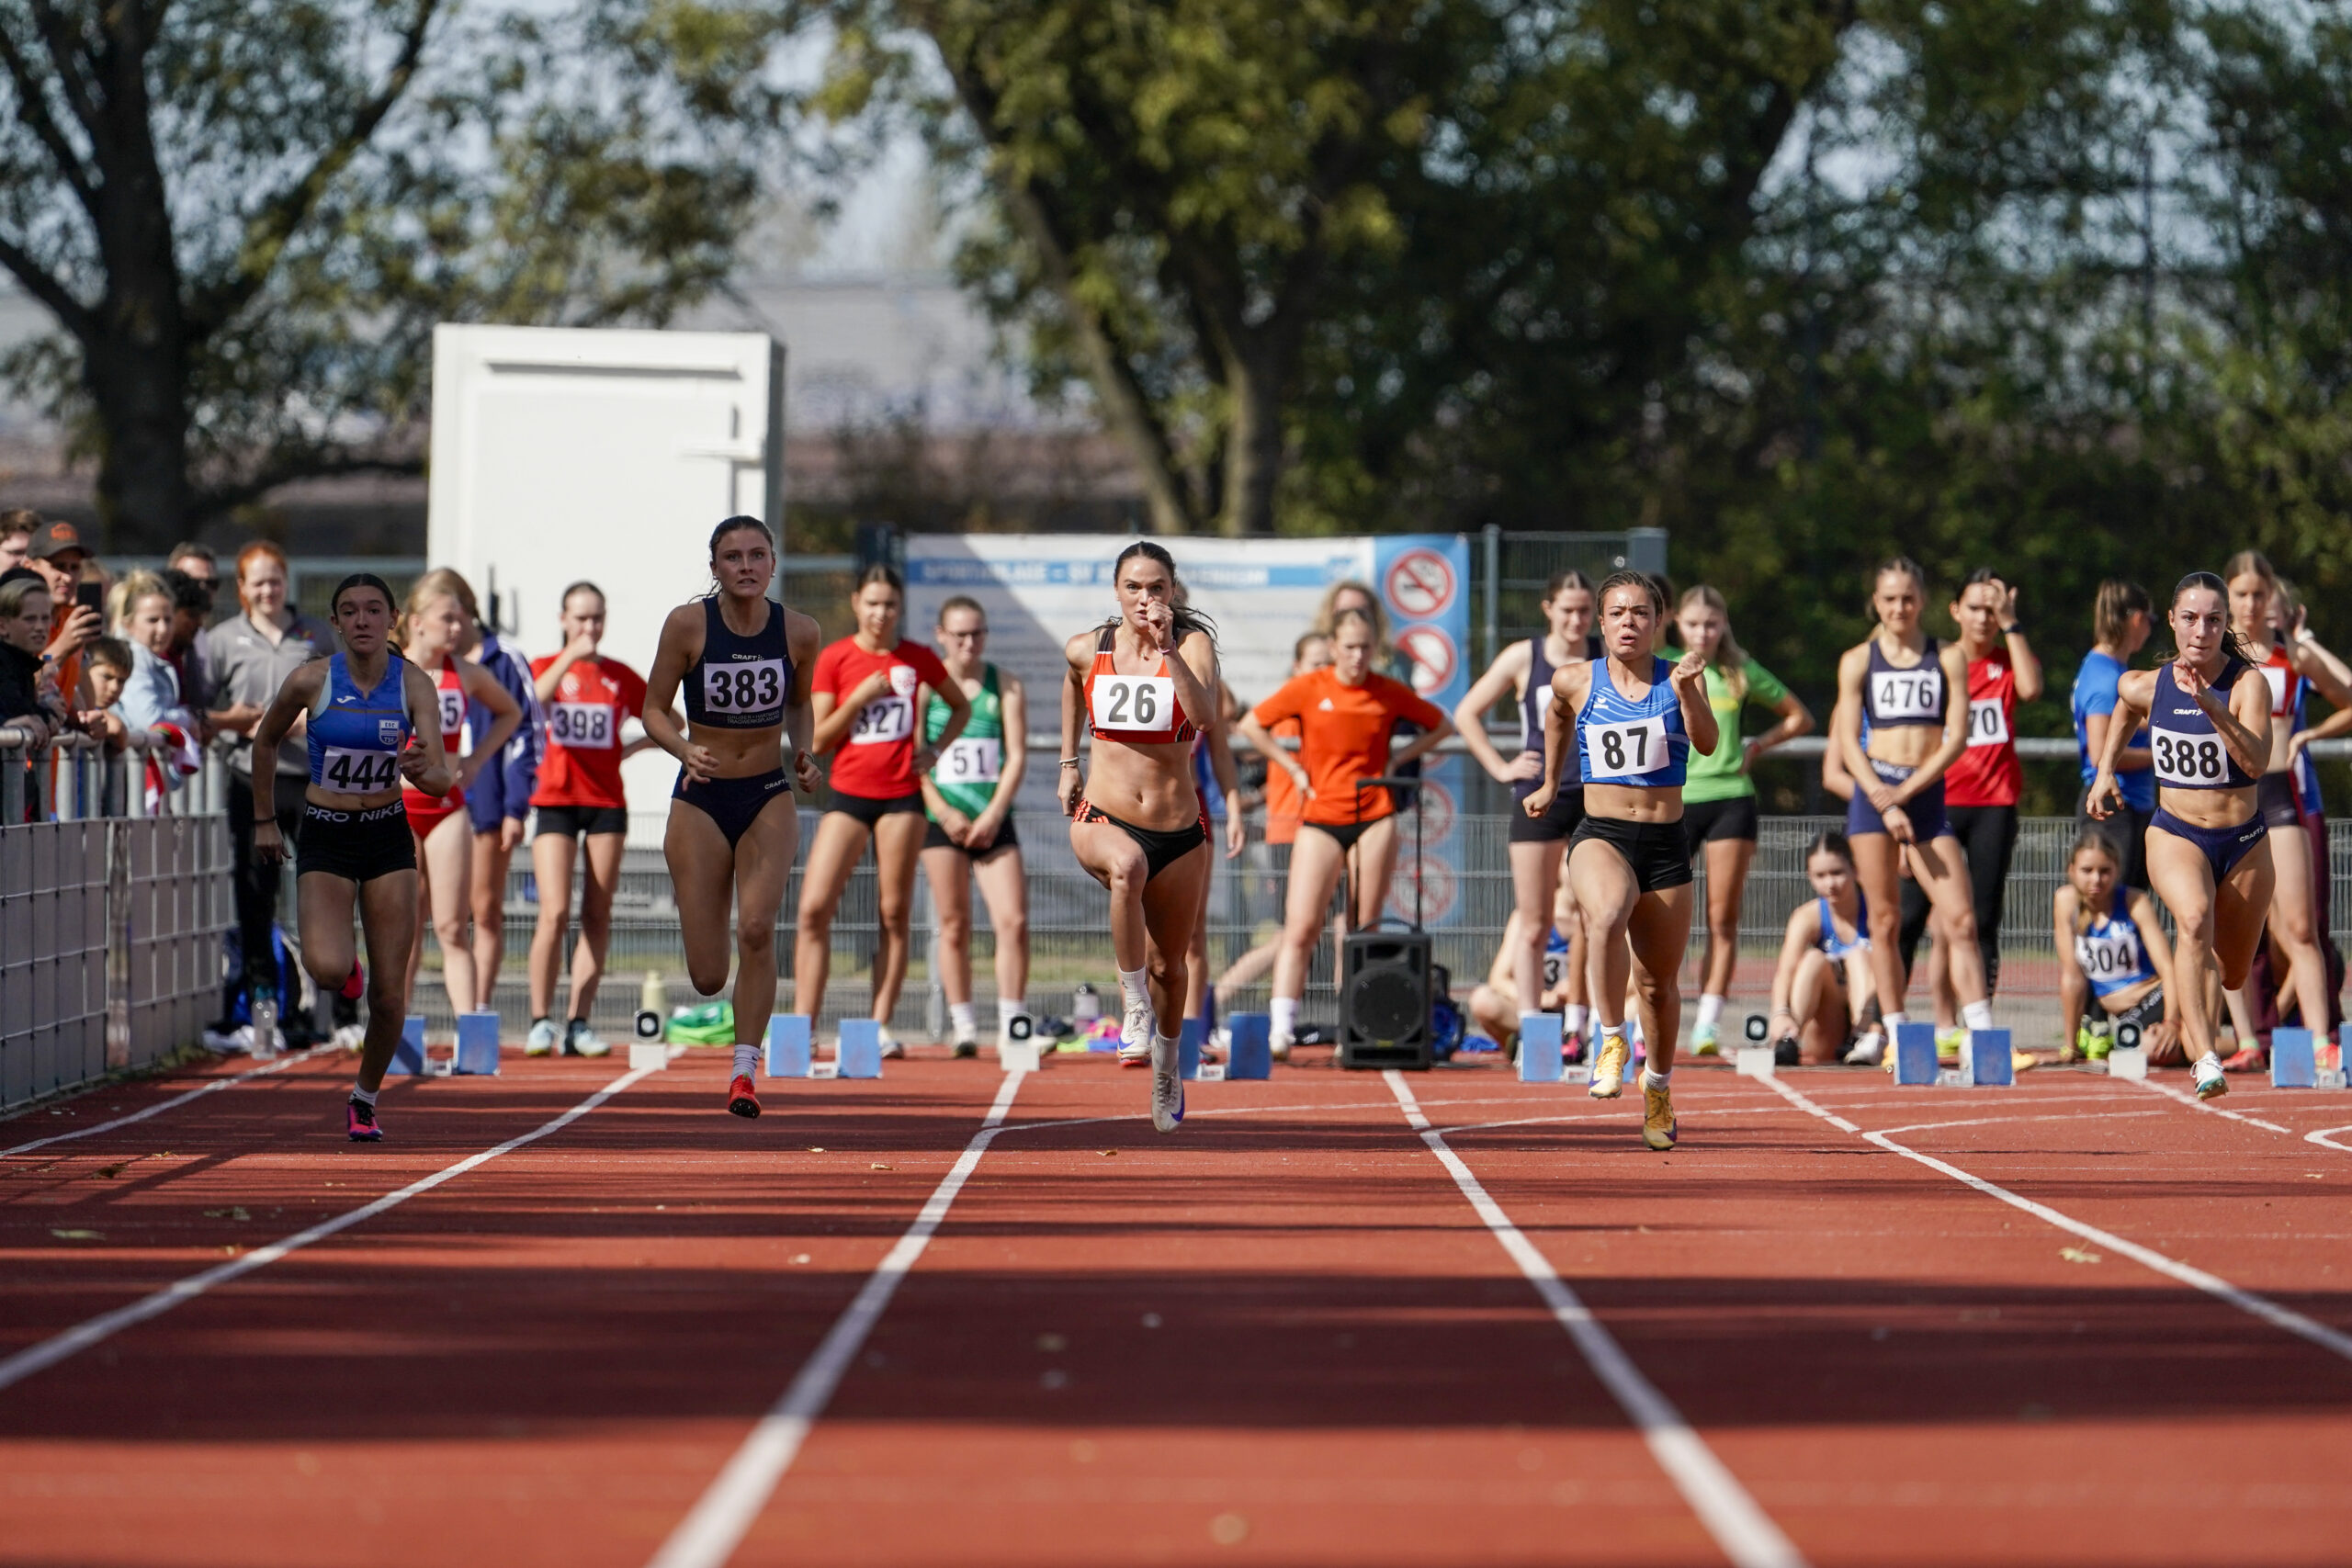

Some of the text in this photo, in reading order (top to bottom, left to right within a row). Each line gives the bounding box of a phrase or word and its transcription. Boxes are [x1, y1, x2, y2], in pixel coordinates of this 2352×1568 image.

[710, 667, 778, 708] 383
[1108, 682, 1156, 724] 26
[1881, 680, 1933, 708] 476
[556, 708, 605, 740] 398
[954, 746, 985, 775] 51
[1601, 727, 1648, 770] 87
[2156, 736, 2221, 778] 388
[328, 755, 397, 790] 444
[764, 779, 786, 790] CRAFT
[306, 800, 403, 822] PRO NIKE
[2239, 827, 2264, 842] CRAFT
